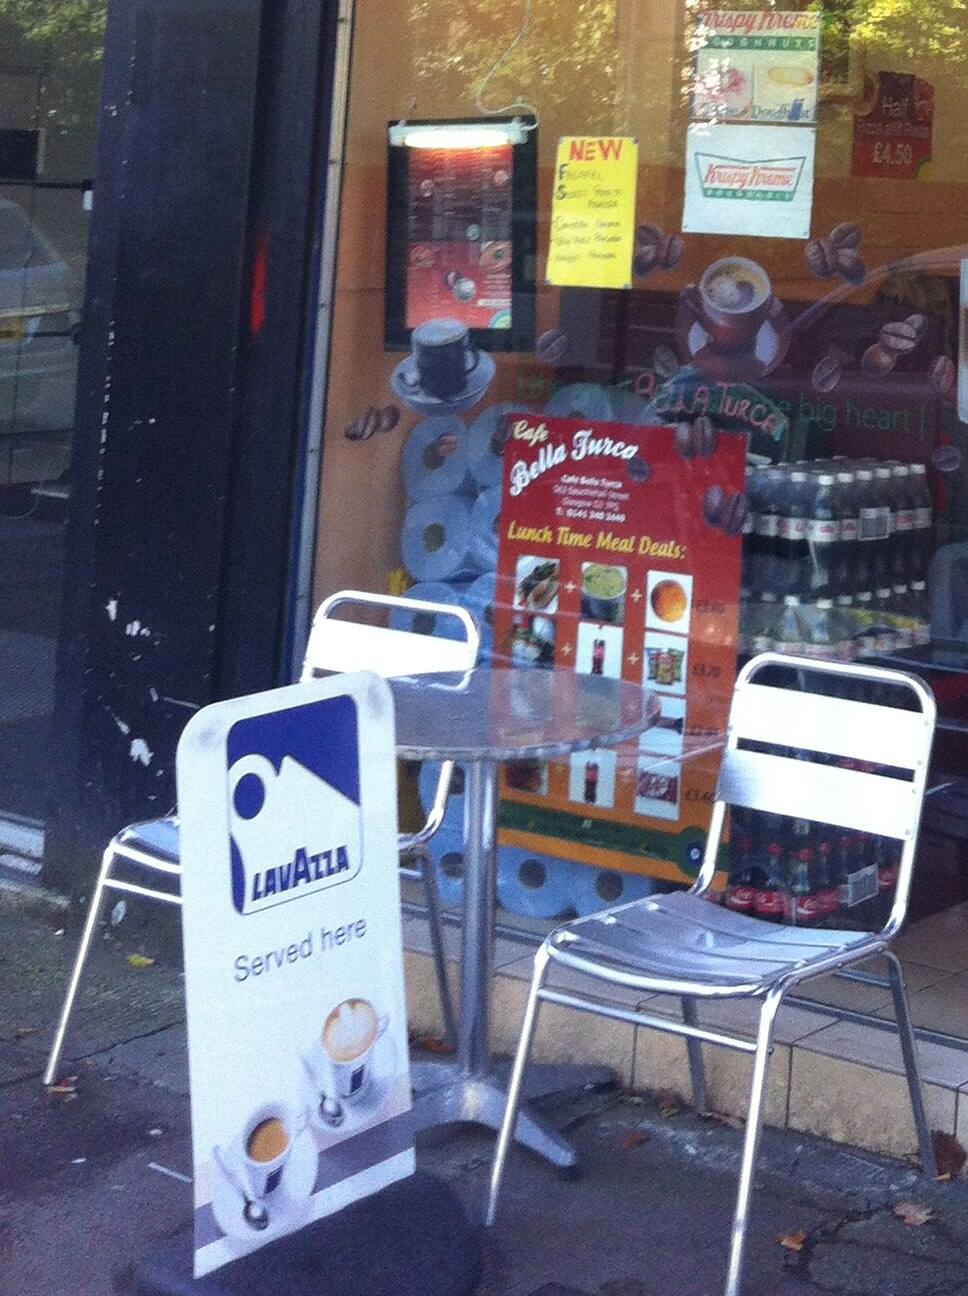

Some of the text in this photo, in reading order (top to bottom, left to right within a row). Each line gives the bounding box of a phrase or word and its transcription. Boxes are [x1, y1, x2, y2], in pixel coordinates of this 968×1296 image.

[569, 138, 622, 161] NEW
[512, 419, 549, 447] Cafe
[509, 428, 640, 496] Bella Turca
[507, 520, 688, 560] Lunch Time Meal Deals:
[252, 845, 350, 901] LAVAZZA
[234, 918, 367, 983] Served here
